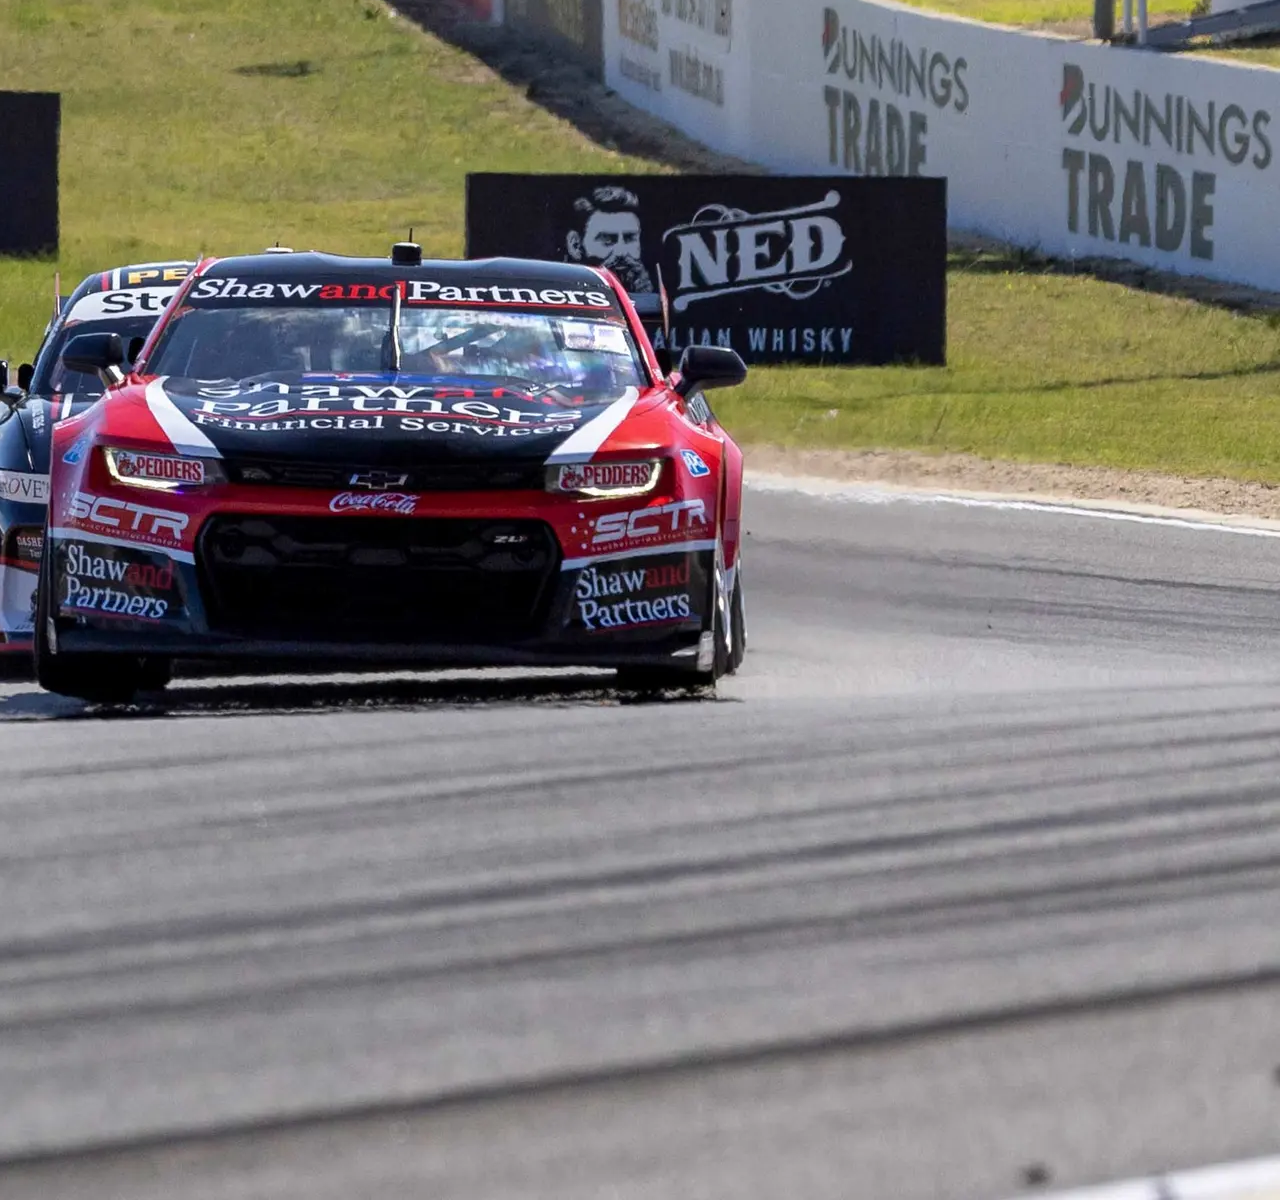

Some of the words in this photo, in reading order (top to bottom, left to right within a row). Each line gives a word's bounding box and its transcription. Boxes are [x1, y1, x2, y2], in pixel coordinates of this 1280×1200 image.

[822, 7, 969, 112] BUNNINGS
[823, 85, 928, 177] TRADE
[1059, 63, 1272, 170] BUNNINGS
[1062, 148, 1216, 261] TRADE
[677, 215, 847, 290] NED
[748, 326, 854, 353] WHISKY
[195, 414, 384, 431] Financial
[401, 417, 575, 437] Services
[197, 395, 583, 425] Partners
[137, 456, 203, 483] PEDDERS
[583, 463, 650, 487] PEDDERS
[68, 490, 190, 540] SCTR
[592, 498, 707, 543] SCTR
[65, 575, 169, 620] Partners
[577, 593, 690, 630] Partners
